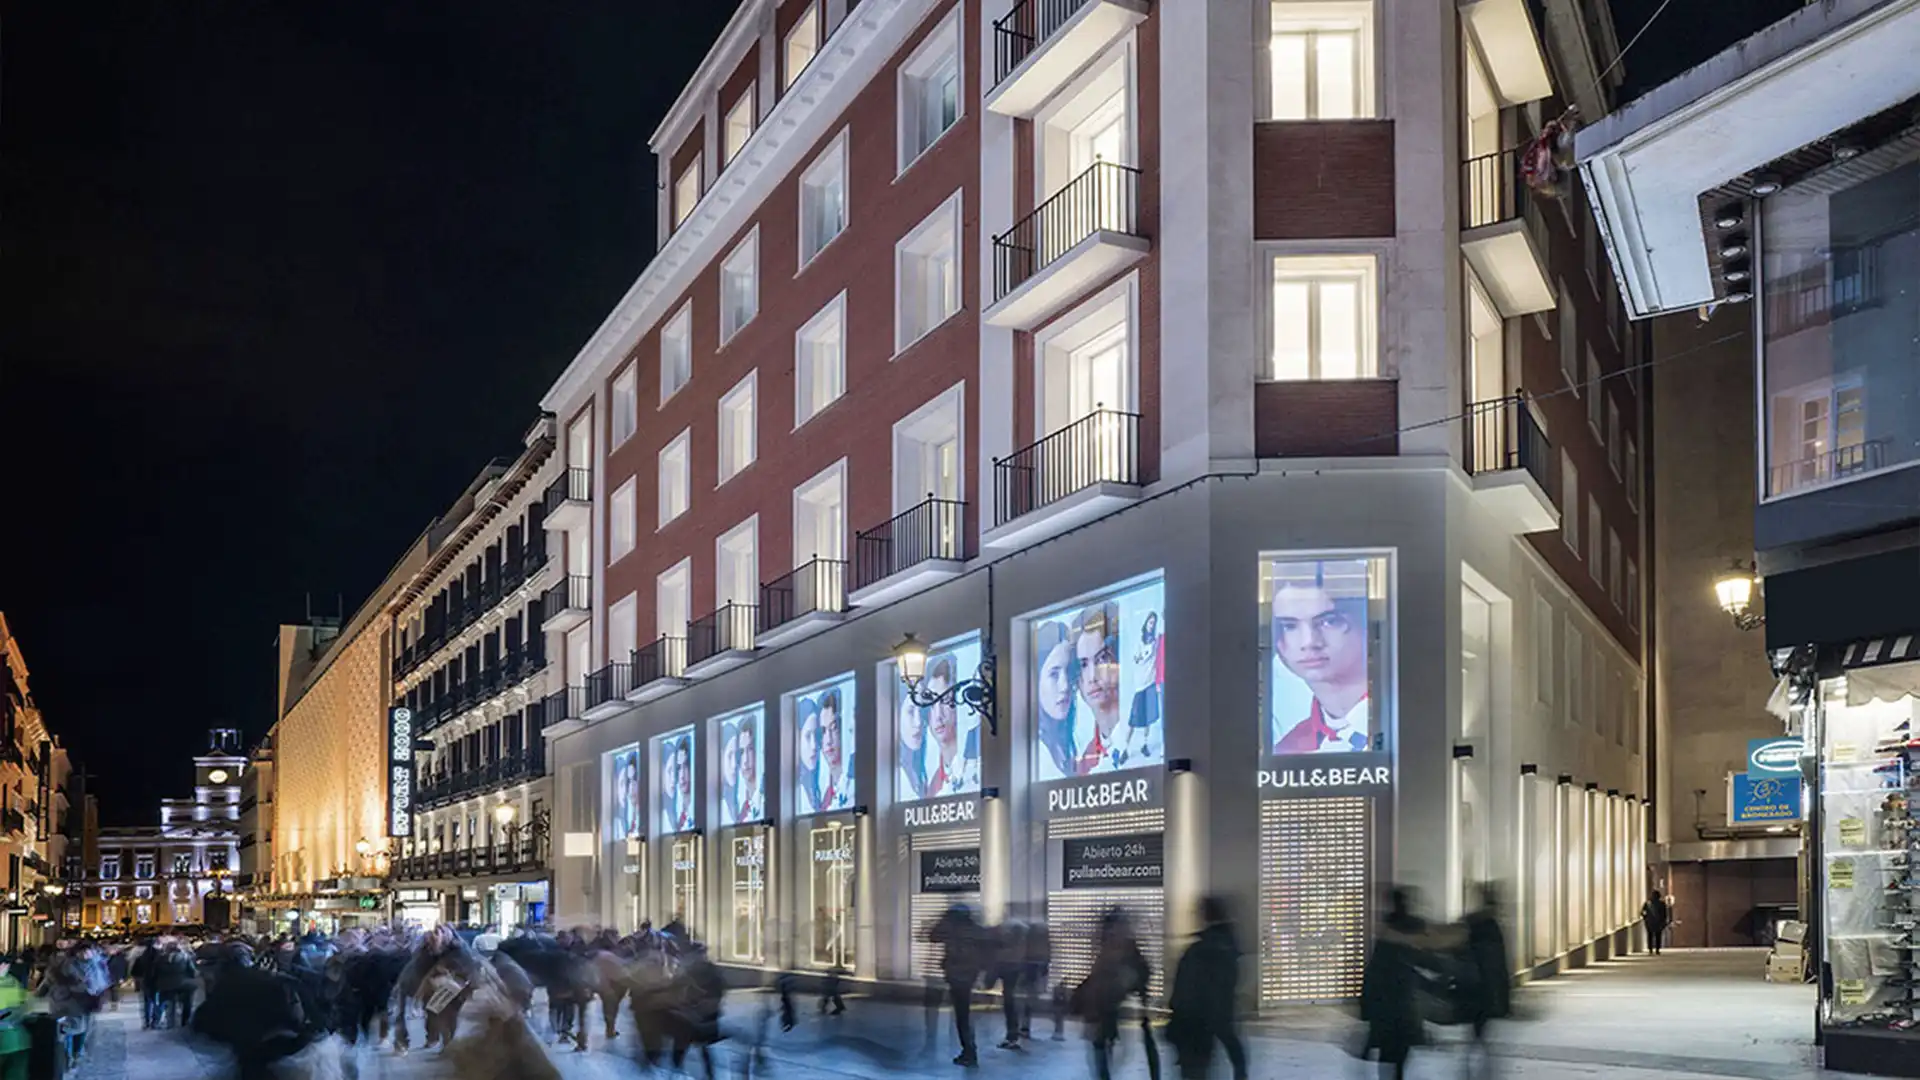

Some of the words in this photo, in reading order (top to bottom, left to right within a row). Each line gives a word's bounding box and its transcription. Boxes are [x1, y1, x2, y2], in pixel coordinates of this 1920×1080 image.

[1257, 766, 1391, 788] PULL&BEAR
[393, 766, 410, 836] SPORT
[1048, 779, 1148, 811] PULL&BEAR
[904, 801, 975, 827] PULL&BEAR
[1082, 843, 1122, 860] Abierto
[1124, 840, 1146, 857] 24h
[1069, 862, 1161, 881] pullandbear.com
